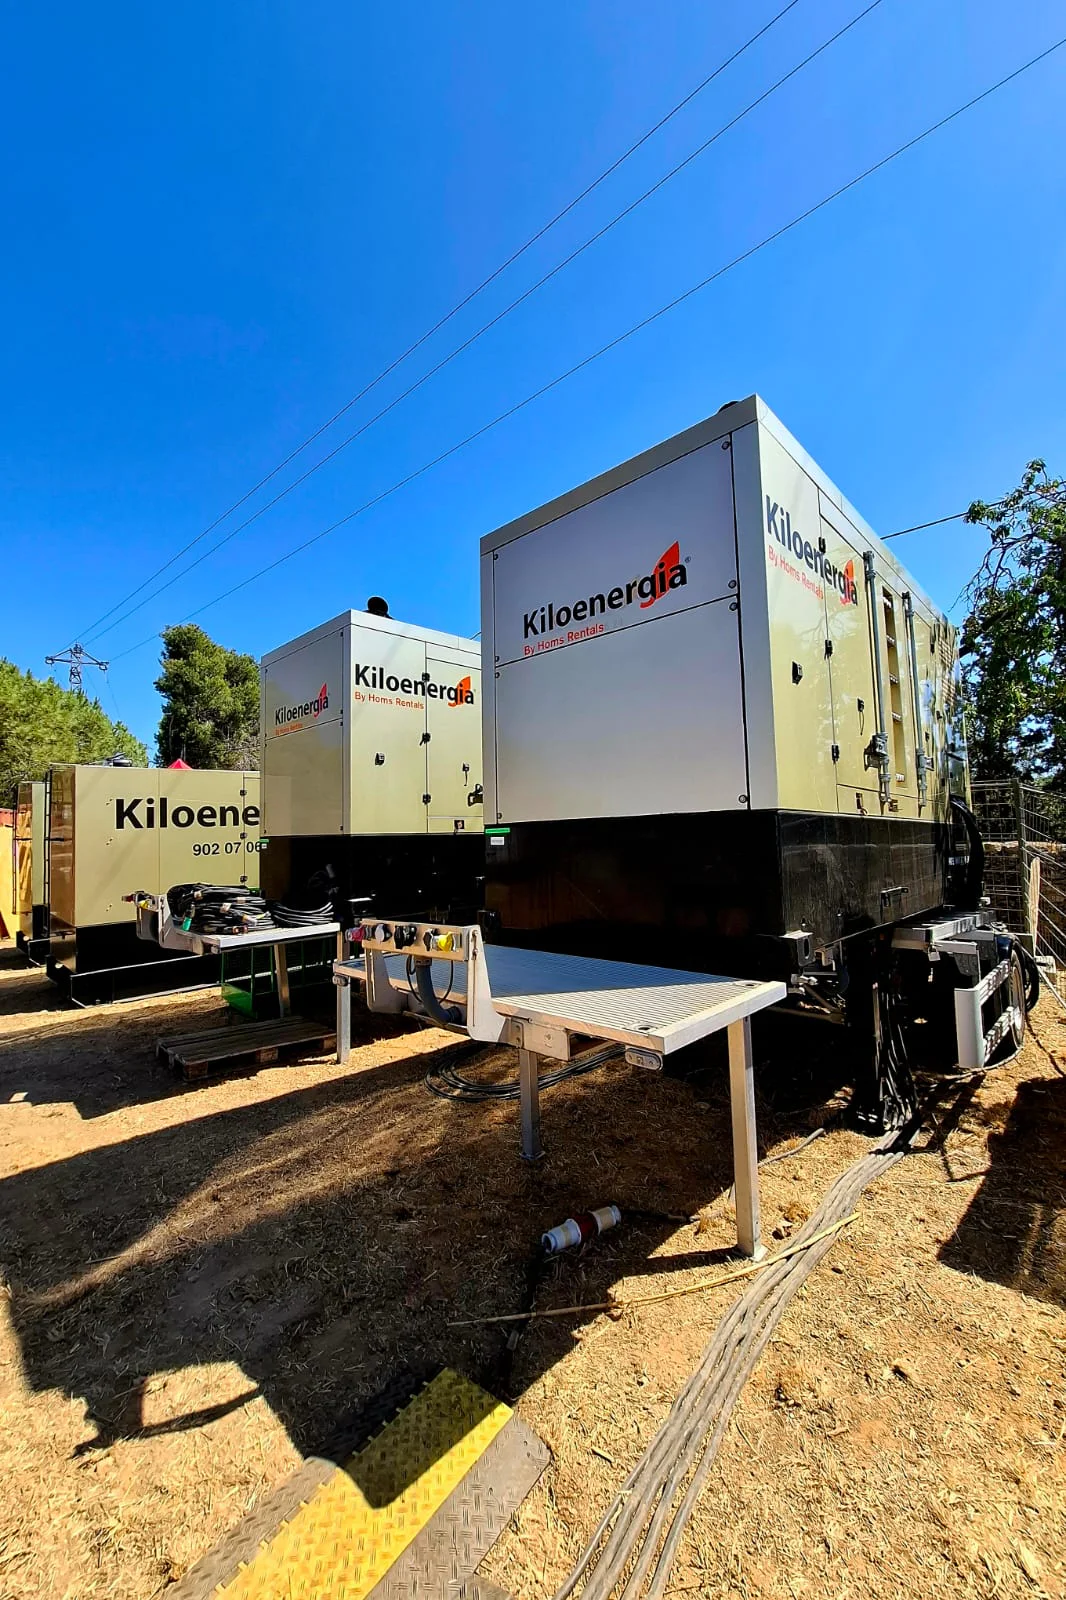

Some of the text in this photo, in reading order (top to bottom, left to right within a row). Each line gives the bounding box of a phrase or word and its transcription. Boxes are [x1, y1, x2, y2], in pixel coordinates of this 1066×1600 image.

[765, 494, 858, 606] Kiloenergia
[523, 560, 688, 639] Kiloenergia
[524, 623, 605, 656] By Homs Rentals
[354, 691, 424, 710] By Homs Rentals
[355, 663, 474, 707] Kiloenergia
[275, 692, 329, 726] Kiloenergia
[192, 843, 220, 856] 902
[224, 842, 241, 854] 07
